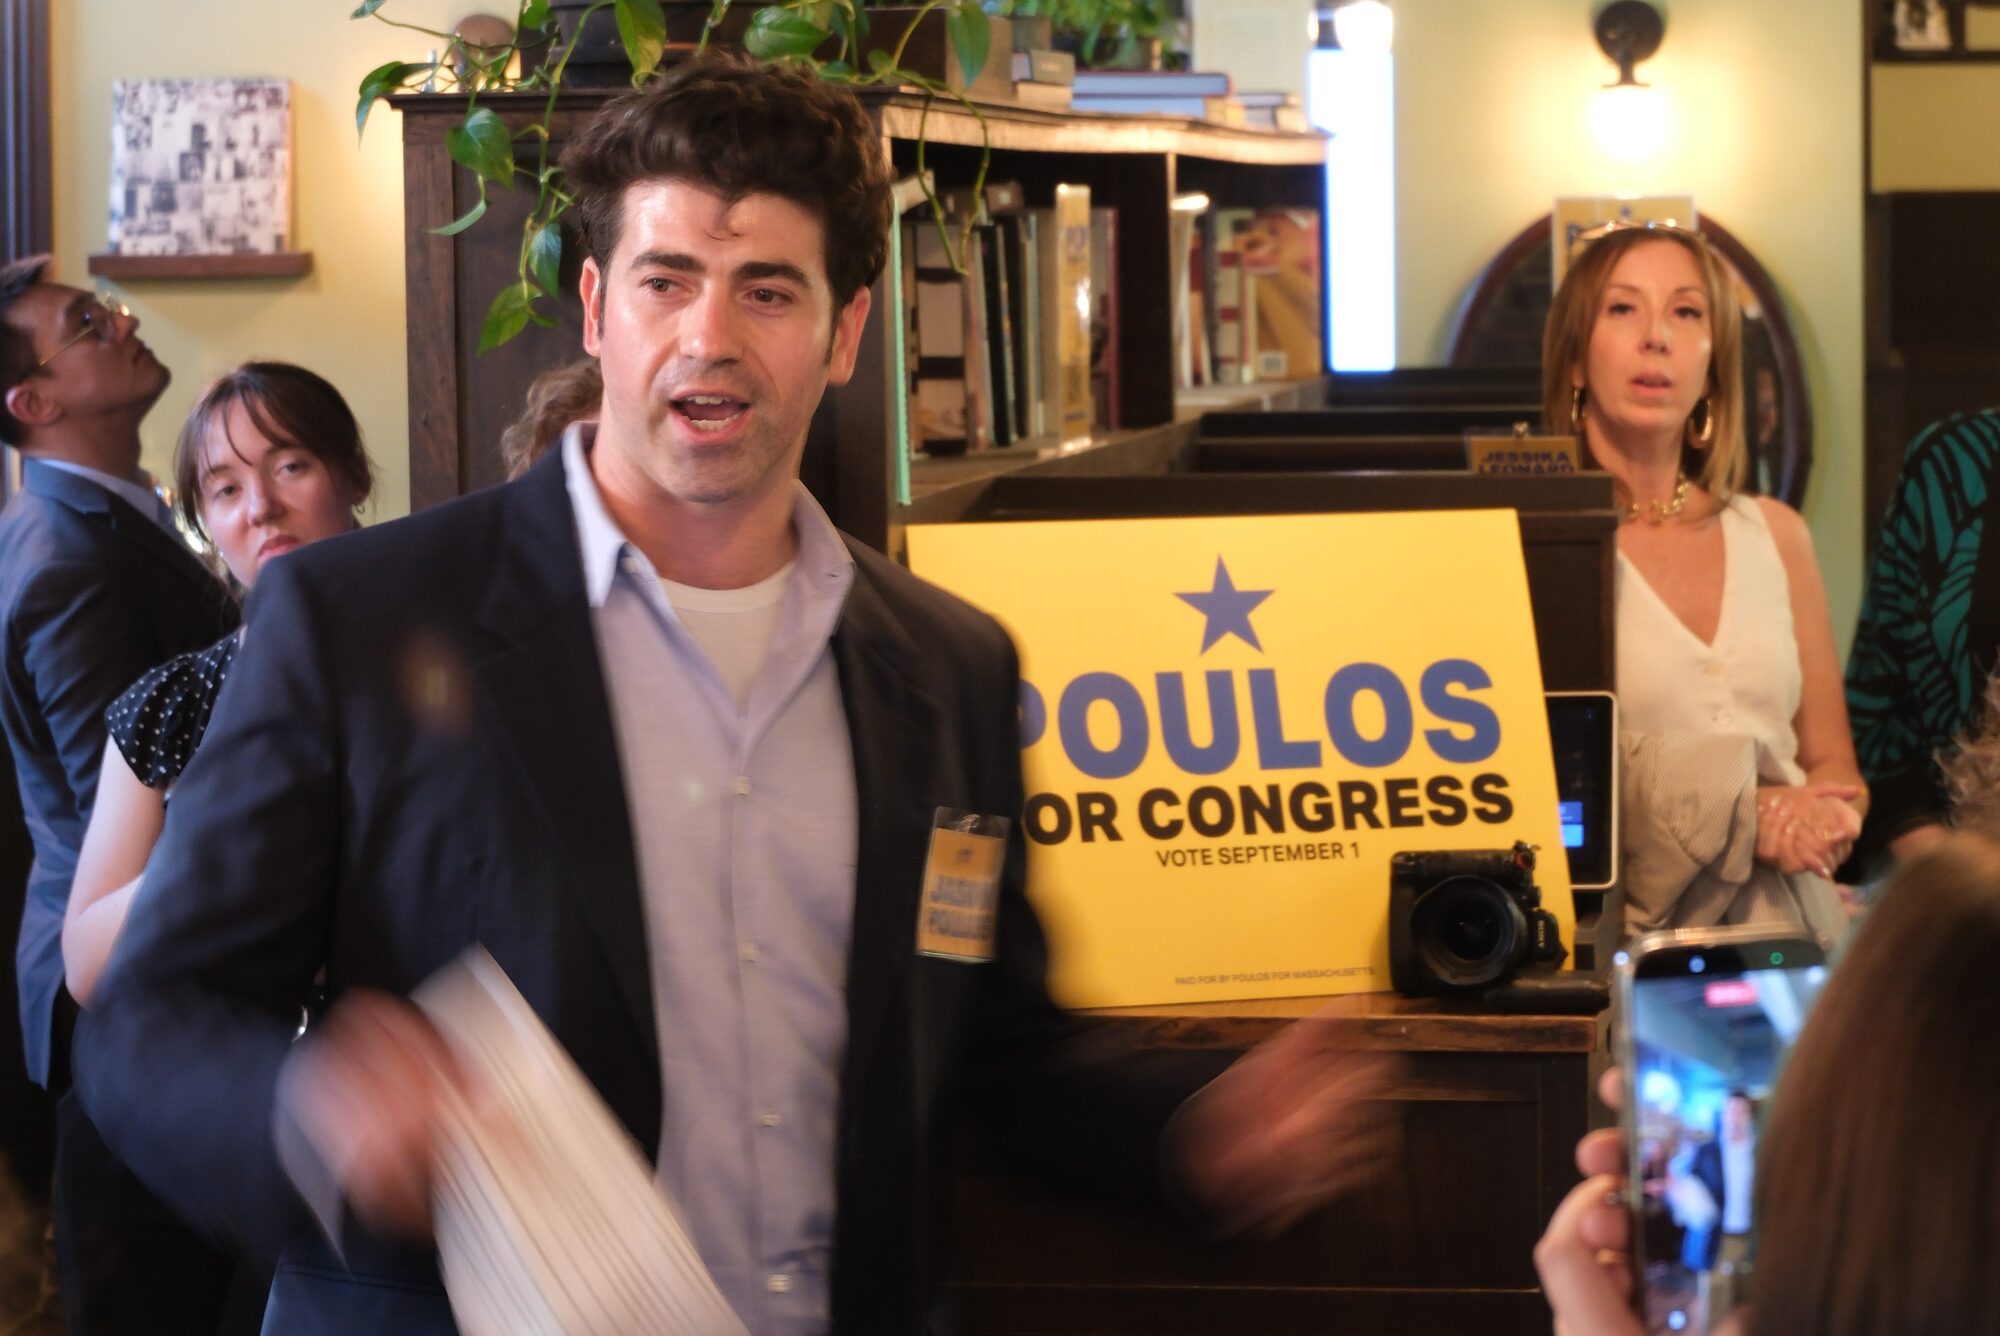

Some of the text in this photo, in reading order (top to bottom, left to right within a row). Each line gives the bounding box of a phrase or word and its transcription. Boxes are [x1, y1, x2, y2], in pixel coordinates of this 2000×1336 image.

[1481, 451, 1570, 462] JESSIKA
[1025, 773, 1514, 846] OR CONGRESS
[1156, 842, 1360, 867] VOTE SEPTEMBER 1
